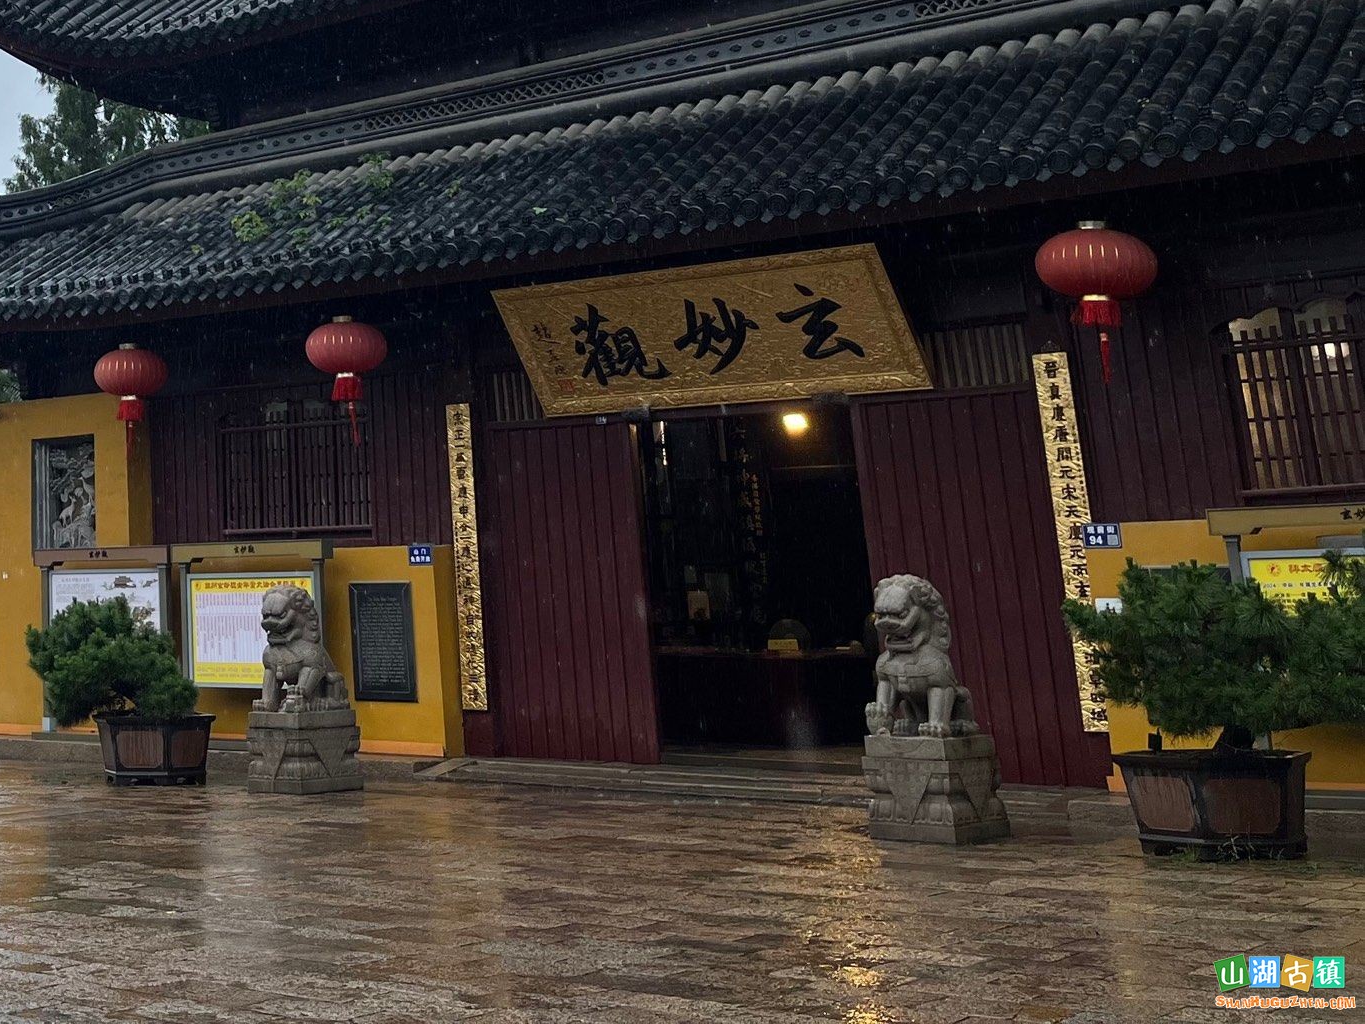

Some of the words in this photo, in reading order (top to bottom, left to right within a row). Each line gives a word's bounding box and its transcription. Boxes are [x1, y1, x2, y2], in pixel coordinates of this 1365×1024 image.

[570, 283, 865, 386] 玄妙觀
[1089, 536, 1103, 545] 94
